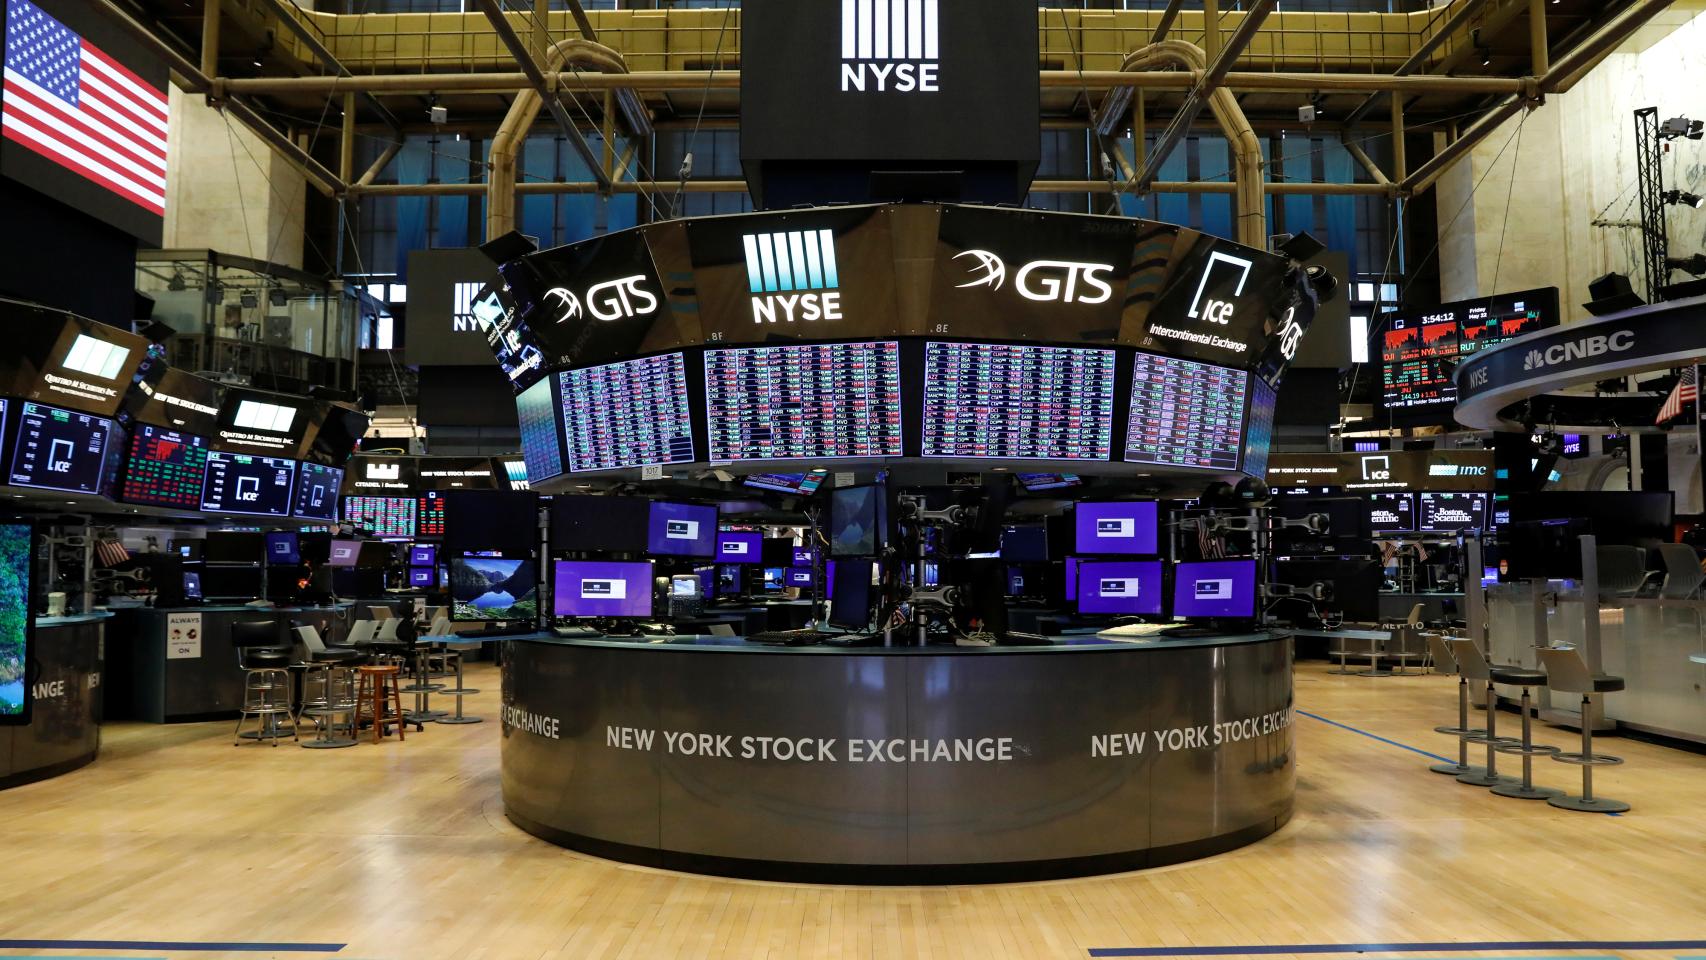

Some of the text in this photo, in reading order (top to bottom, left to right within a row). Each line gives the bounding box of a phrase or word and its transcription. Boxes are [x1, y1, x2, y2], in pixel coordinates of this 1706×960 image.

[841, 63, 939, 92] NYSE
[1015, 260, 1115, 304] GTS
[586, 275, 658, 321] GTS
[751, 292, 843, 324] NYSE
[453, 316, 477, 332] NY
[936, 324, 949, 333] 8E
[1422, 312, 1454, 324] 3:54:12
[1150, 323, 1248, 353] Intercontinental Exchange
[1460, 342, 1476, 351] RUT
[1544, 330, 1635, 366] CNBC
[1421, 348, 1436, 356] NYA
[1470, 366, 1488, 390] NYSE
[1564, 443, 1580, 454] NYSE
[510, 480, 530, 490] NYS
[1434, 512, 1472, 522] Scientific
[1440, 508, 1464, 516] Boston
[508, 706, 560, 740] EXCHANGE
[606, 726, 1013, 762] NEW YORK STOCK EXCHANGE
[1091, 732, 1146, 758] NEW
[1154, 725, 1208, 752] YORK
[1213, 716, 1260, 744] STOCK
